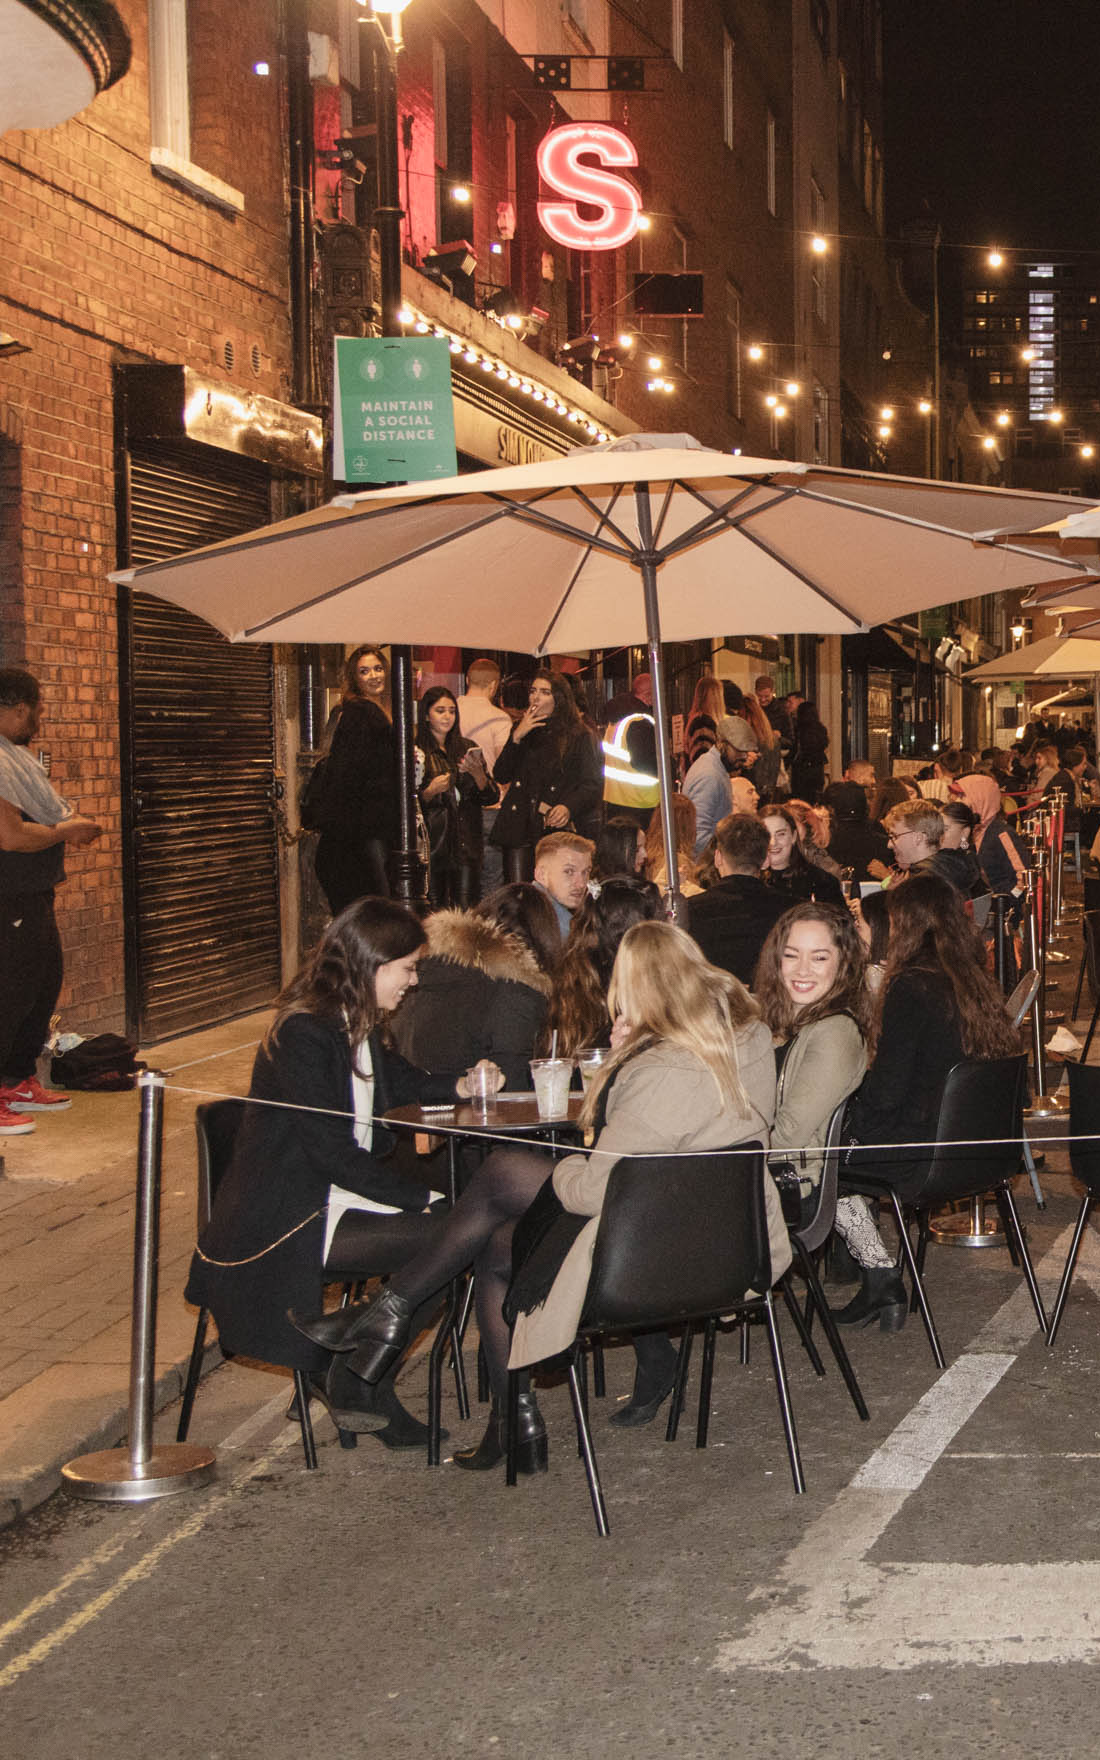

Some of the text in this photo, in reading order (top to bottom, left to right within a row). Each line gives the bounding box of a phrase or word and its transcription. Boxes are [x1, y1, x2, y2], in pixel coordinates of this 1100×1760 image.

[536, 122, 643, 251] S
[361, 400, 433, 412] MAINTAIN
[364, 415, 432, 427] A SOCIAL
[363, 429, 436, 441] DISTANCE
